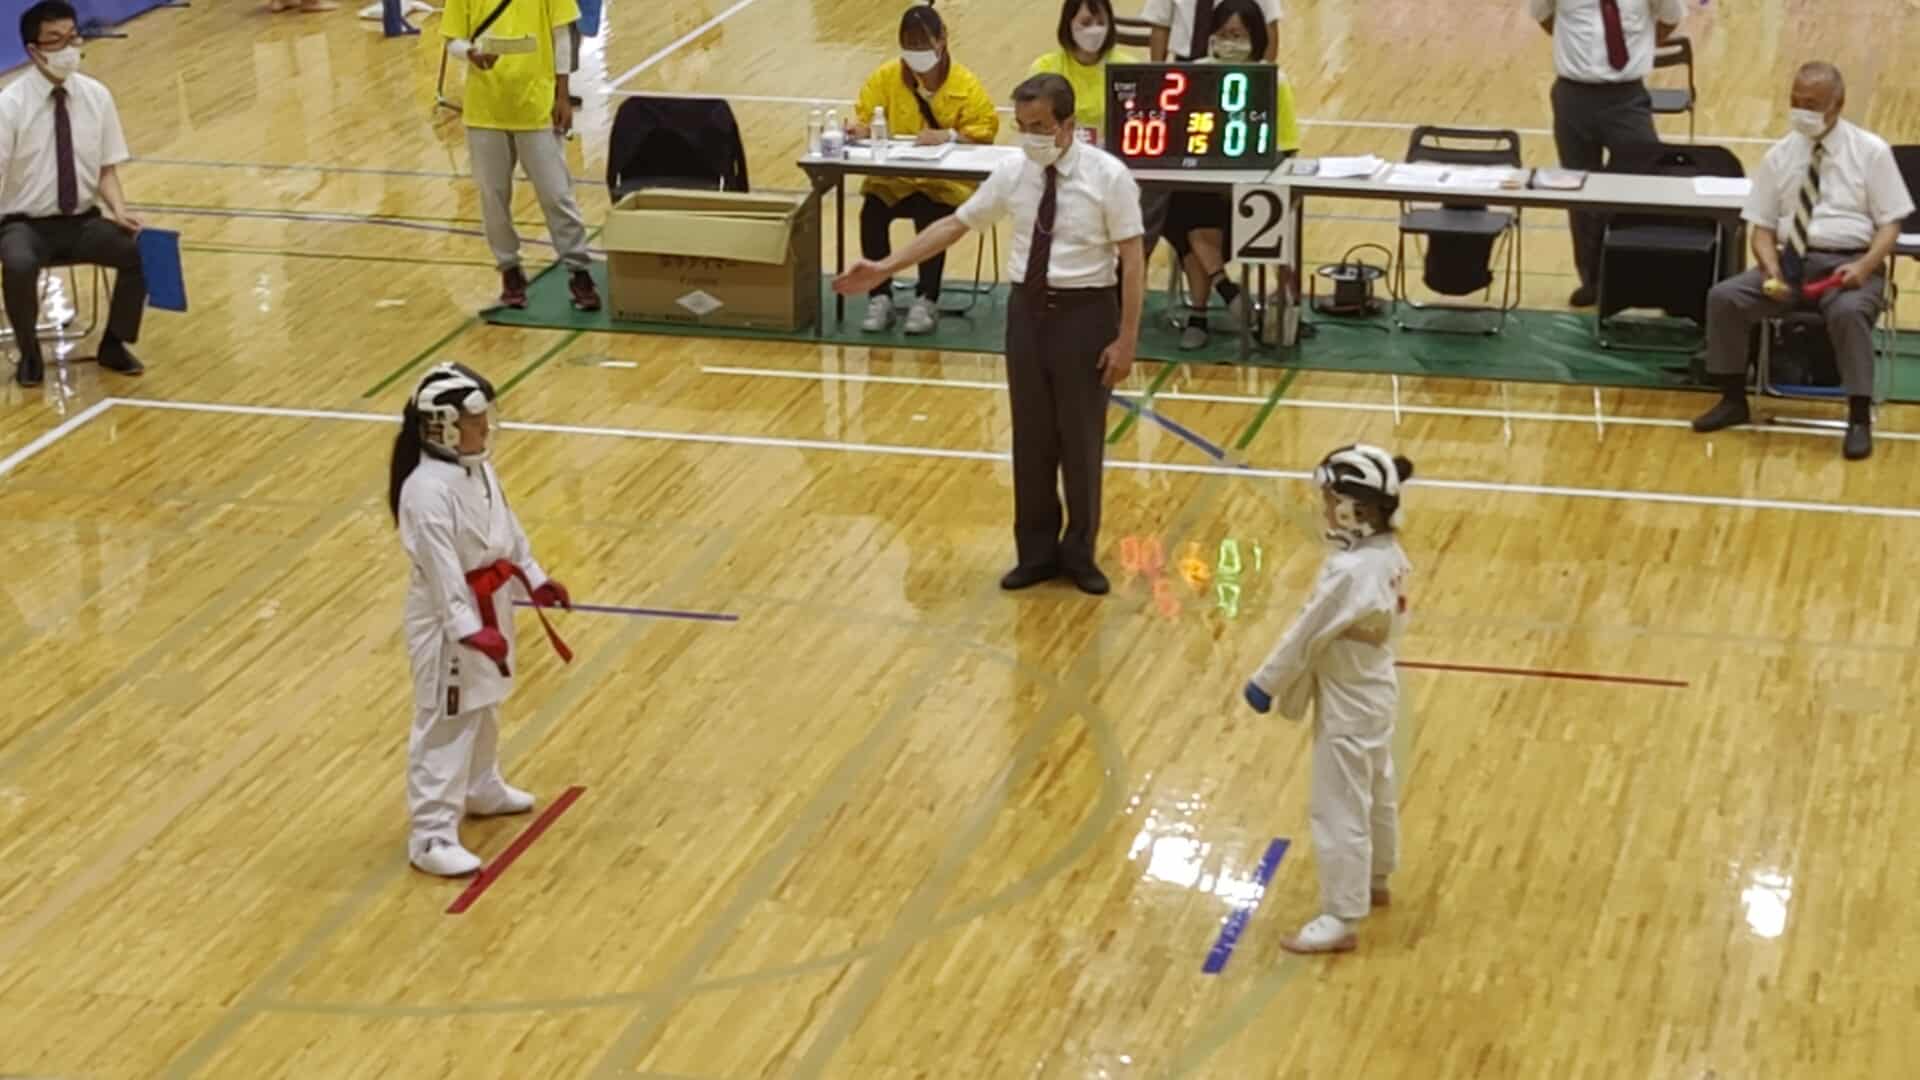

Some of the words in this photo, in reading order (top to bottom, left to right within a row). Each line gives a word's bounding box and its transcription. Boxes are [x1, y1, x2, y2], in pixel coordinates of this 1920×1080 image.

[1160, 72, 1186, 112] 2
[1221, 72, 1248, 112] 0
[1122, 119, 1167, 155] 00
[1187, 133, 1208, 154] 15
[1237, 189, 1283, 258] 2
